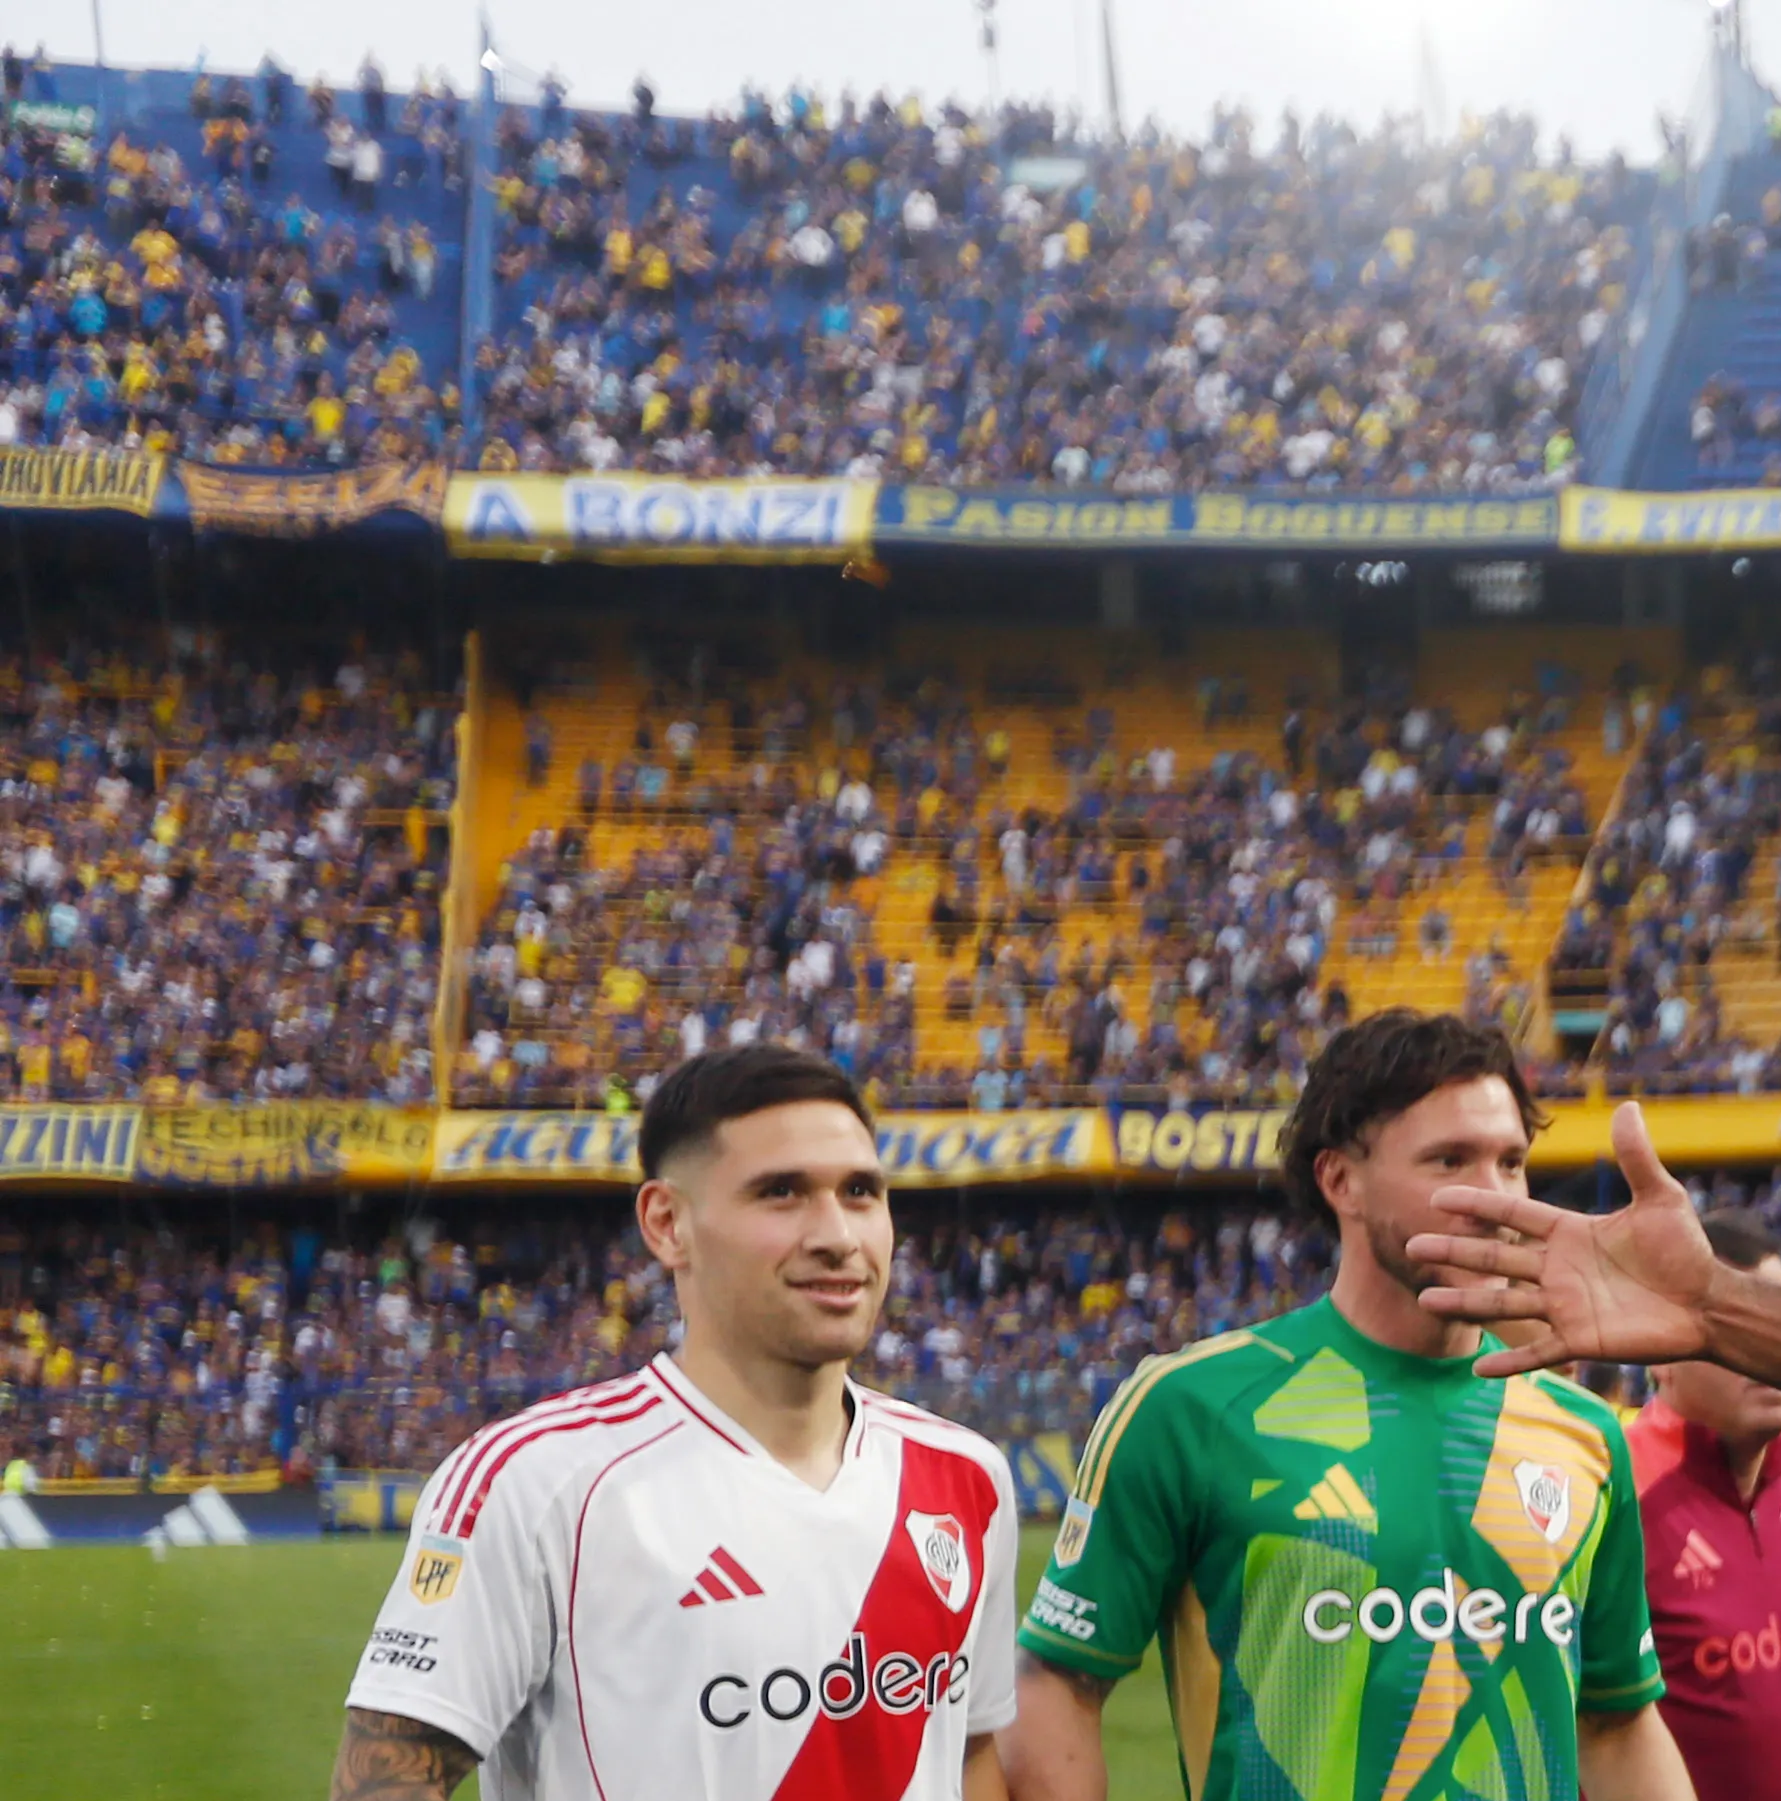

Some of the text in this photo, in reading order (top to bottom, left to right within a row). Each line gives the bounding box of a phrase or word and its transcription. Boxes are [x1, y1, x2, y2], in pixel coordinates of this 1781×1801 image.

[1302, 1567, 1575, 1646] codere
[370, 1648, 438, 1673] CARD
[698, 1630, 971, 1730] codere
